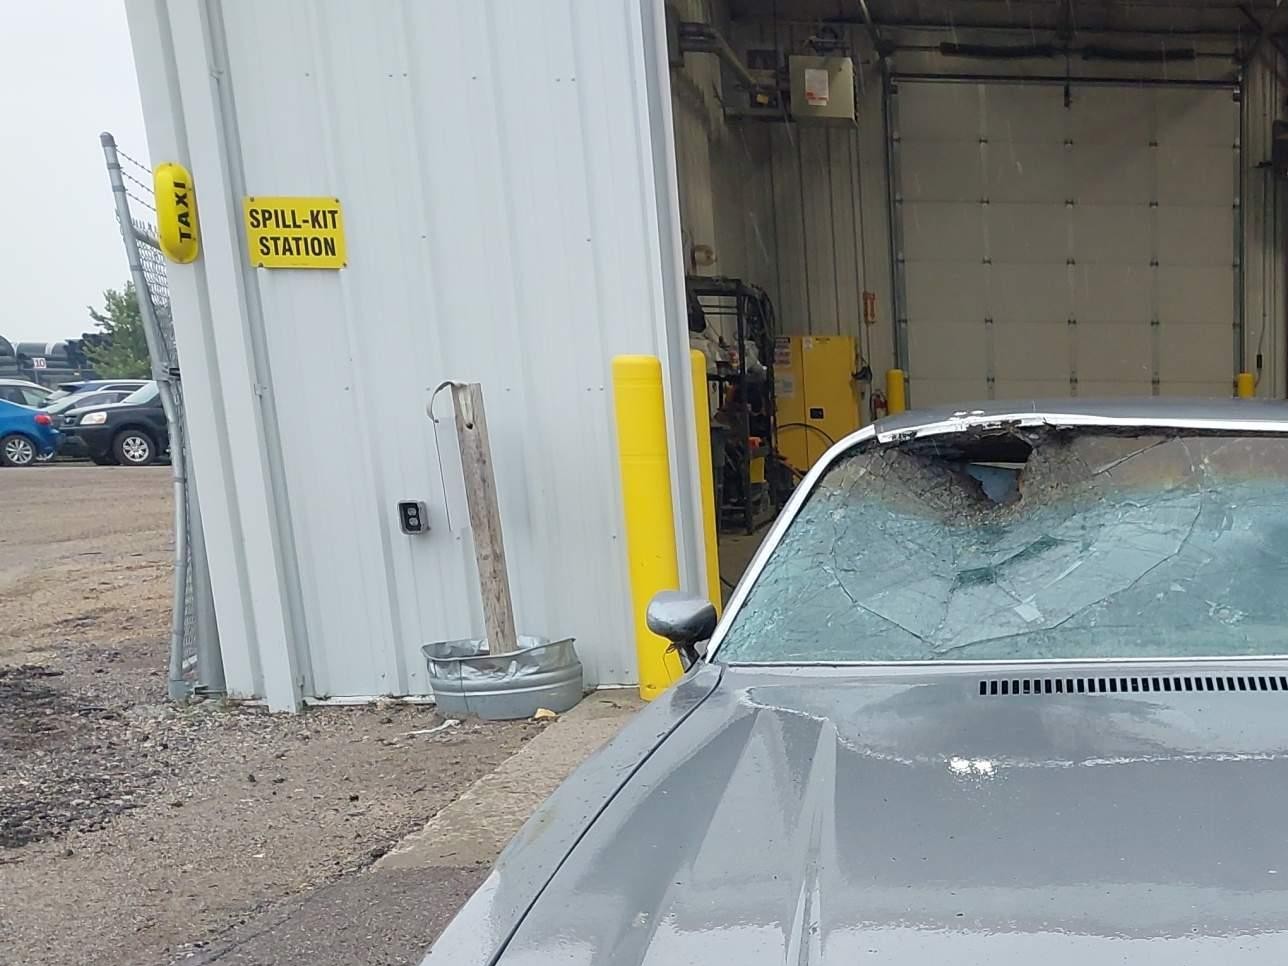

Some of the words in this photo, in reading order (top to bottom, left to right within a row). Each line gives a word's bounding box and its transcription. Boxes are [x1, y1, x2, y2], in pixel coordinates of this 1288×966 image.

[173, 181, 192, 243] TAXI
[249, 208, 339, 230] SPILL-KIT
[258, 236, 337, 257] STATION
[35, 358, 46, 368] 10
